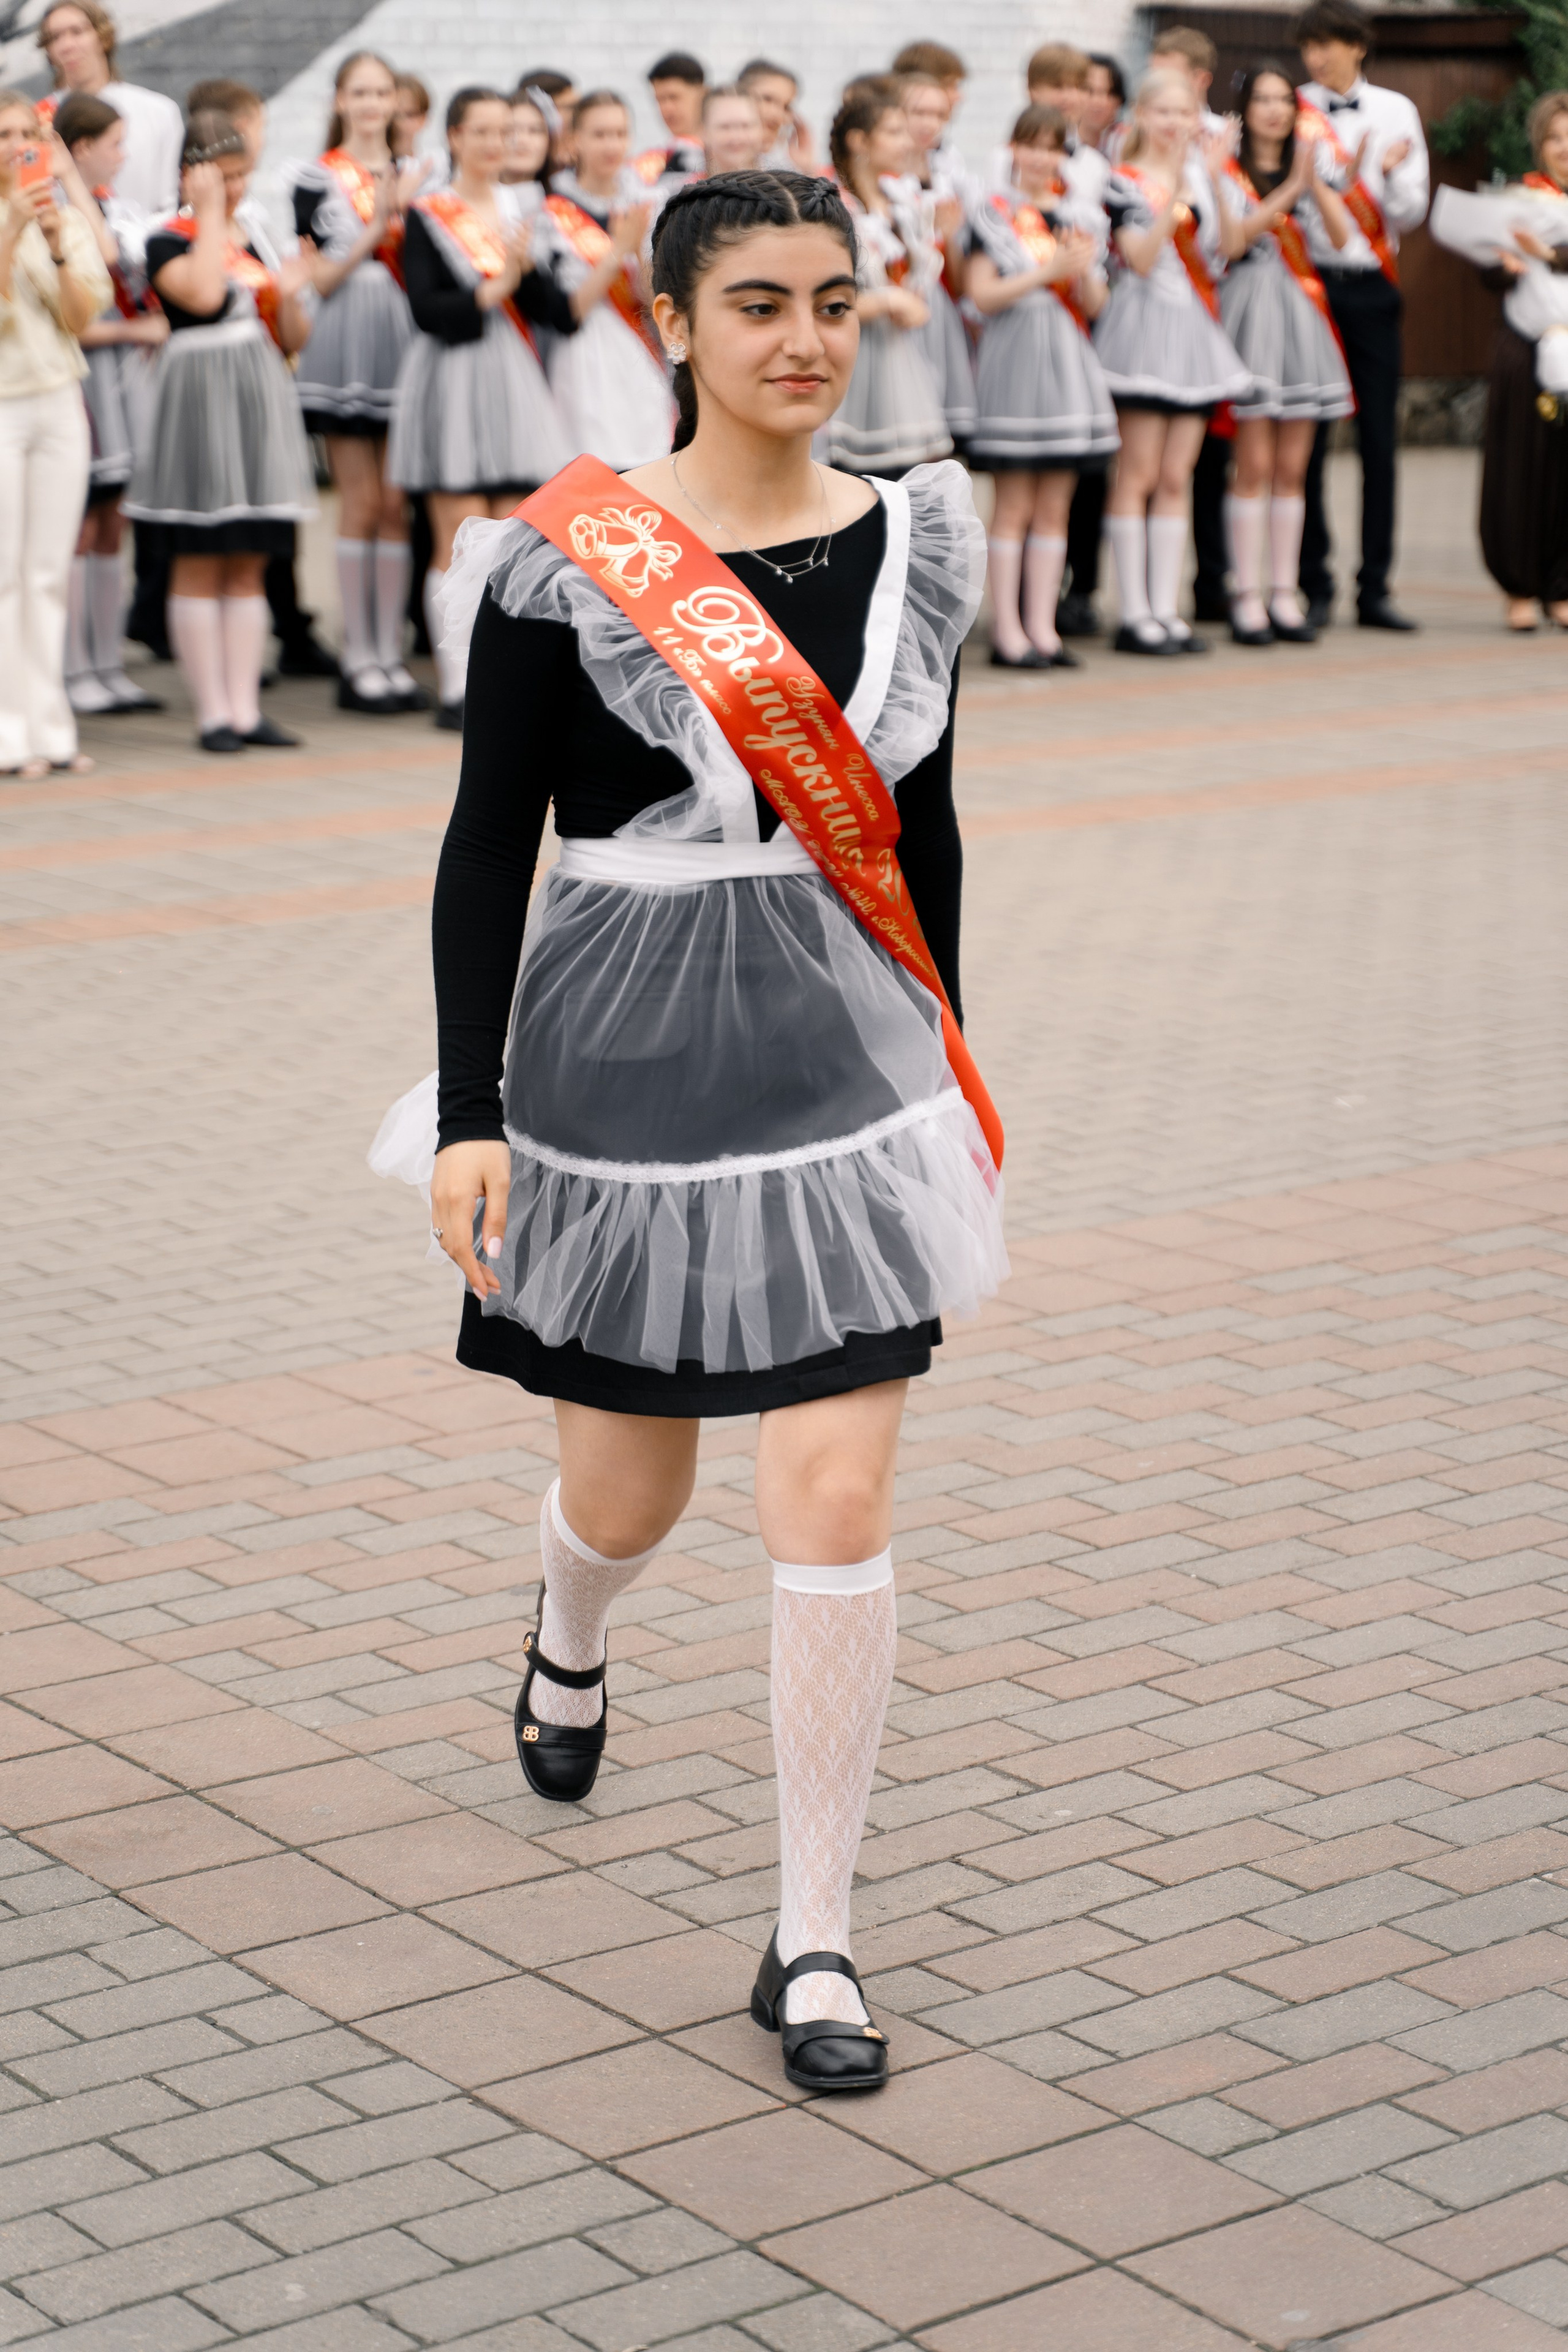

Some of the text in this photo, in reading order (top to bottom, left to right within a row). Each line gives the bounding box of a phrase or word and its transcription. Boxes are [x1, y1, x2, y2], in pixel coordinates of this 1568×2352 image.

[653, 627, 684, 646] 11
[699, 679, 731, 715] класс
[786, 676, 880, 821] Узунян Инесса
